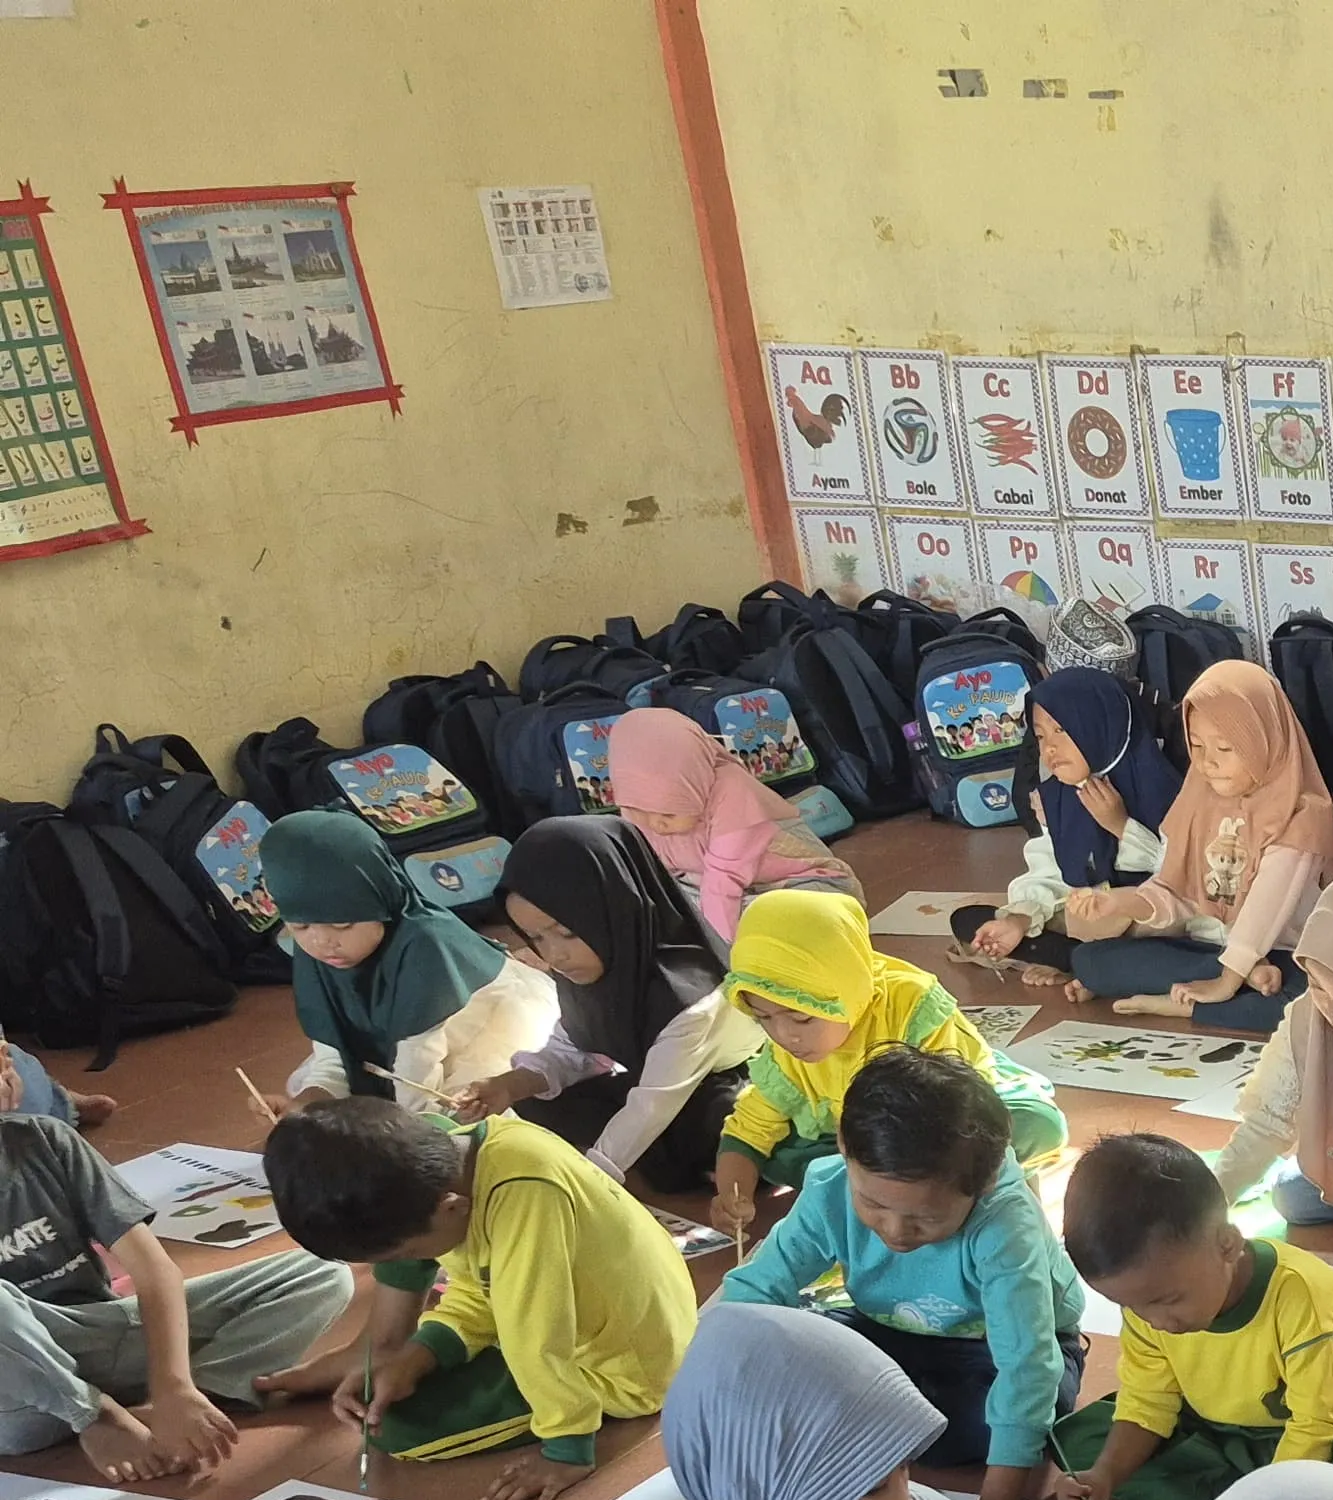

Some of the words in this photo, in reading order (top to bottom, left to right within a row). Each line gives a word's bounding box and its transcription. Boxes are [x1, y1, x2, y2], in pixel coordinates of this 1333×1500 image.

[801, 361, 832, 386] Aa
[890, 364, 920, 390] Bb
[983, 372, 1010, 398] Cc
[1077, 370, 1109, 396] Dd
[1173, 370, 1202, 395] Ee
[1272, 372, 1295, 398] Ff
[812, 474, 850, 490] Ayam
[907, 480, 936, 496] Bola
[1179, 486, 1223, 502] Ember
[995, 488, 1033, 505] Cabai
[1085, 487, 1127, 504] Donat
[1281, 490, 1311, 507] Foto
[825, 521, 856, 544] Nn
[917, 532, 950, 557] Oo
[1009, 535, 1038, 564] Pp
[1098, 537, 1133, 567] Qq
[1194, 555, 1219, 580] Rr
[1289, 560, 1315, 586] Ss
[954, 670, 992, 692] Ayo
[740, 695, 768, 717] Ayo
[969, 689, 1018, 706] PAUD
[592, 721, 612, 741] Ay
[352, 753, 394, 778] Ayo
[216, 817, 248, 849] Ayo
[0, 1216, 58, 1262] KATE
